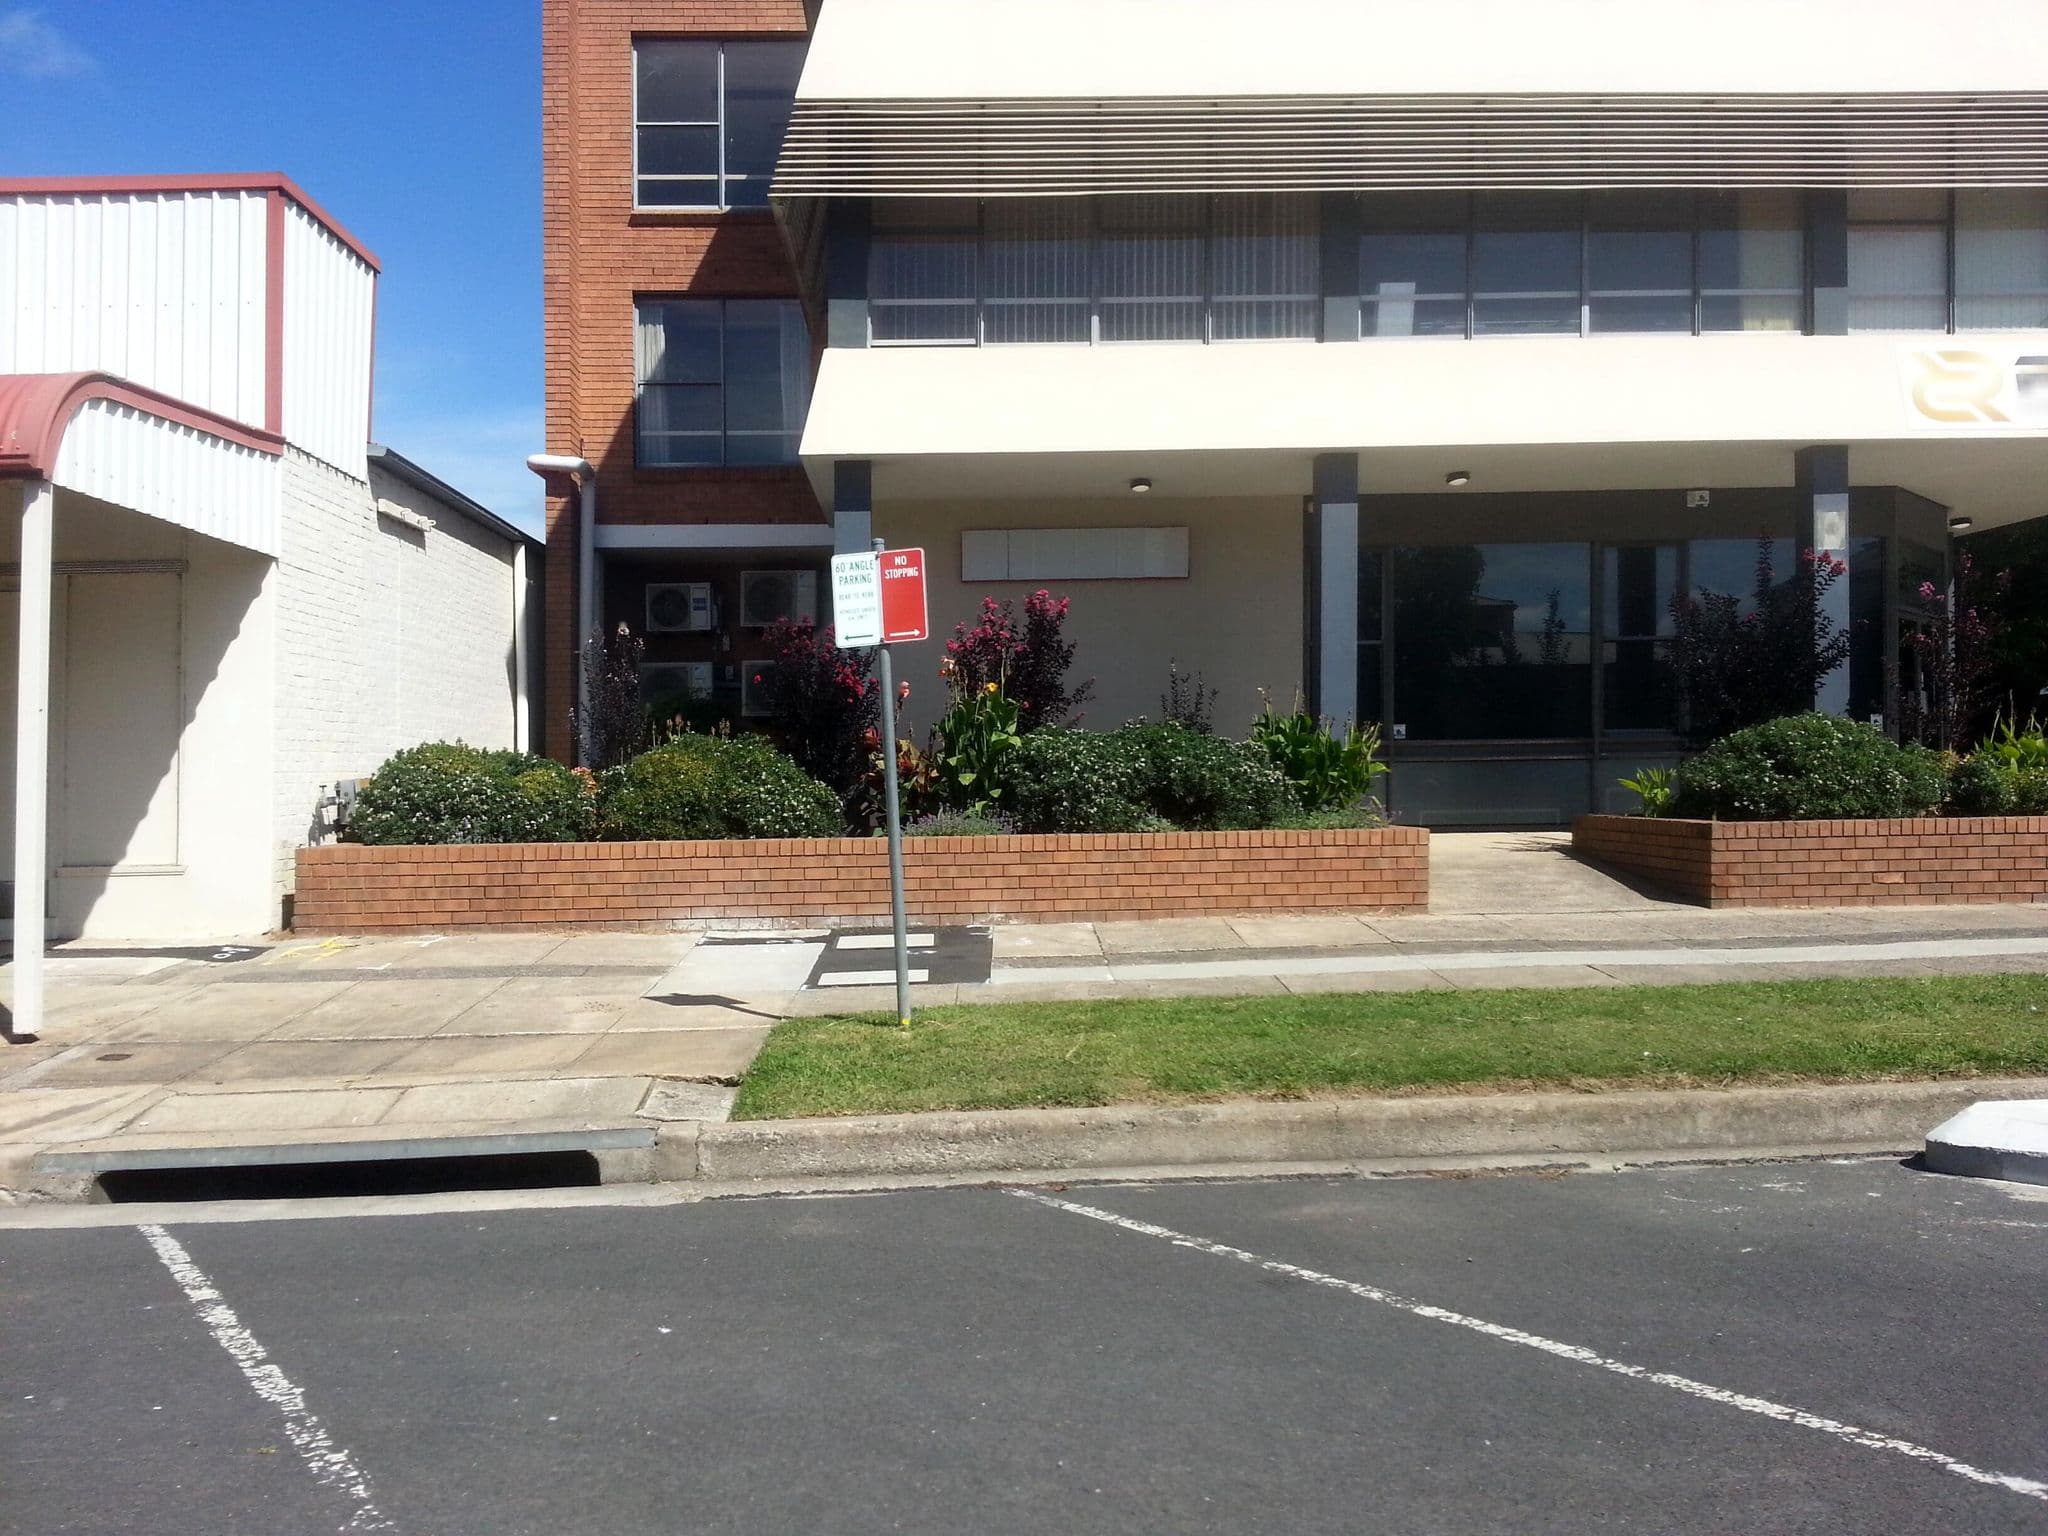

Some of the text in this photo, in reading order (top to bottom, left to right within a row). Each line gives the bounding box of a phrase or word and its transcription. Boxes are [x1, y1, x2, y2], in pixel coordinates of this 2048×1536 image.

[849, 560, 874, 572] ANGLE
[894, 556, 907, 565] NO
[885, 567, 919, 579] STOPPING
[839, 573, 872, 586] PARKING
